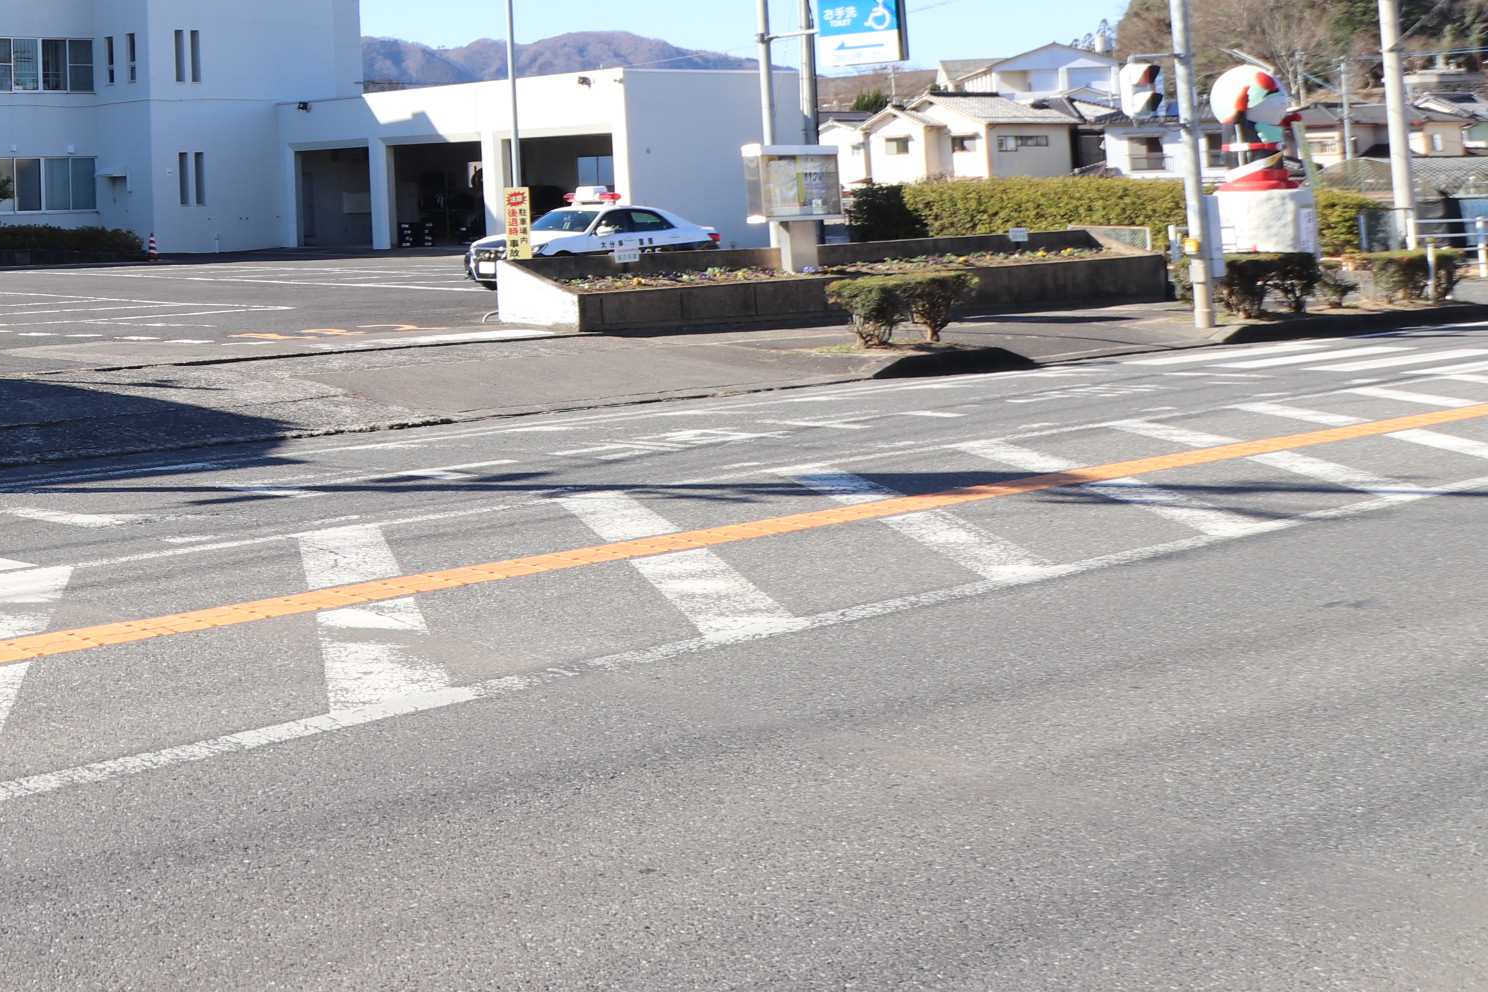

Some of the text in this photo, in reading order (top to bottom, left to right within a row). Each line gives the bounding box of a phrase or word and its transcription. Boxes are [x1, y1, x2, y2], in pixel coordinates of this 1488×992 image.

[823, 5, 858, 21] お手洗
[829, 18, 851, 28] TOILET
